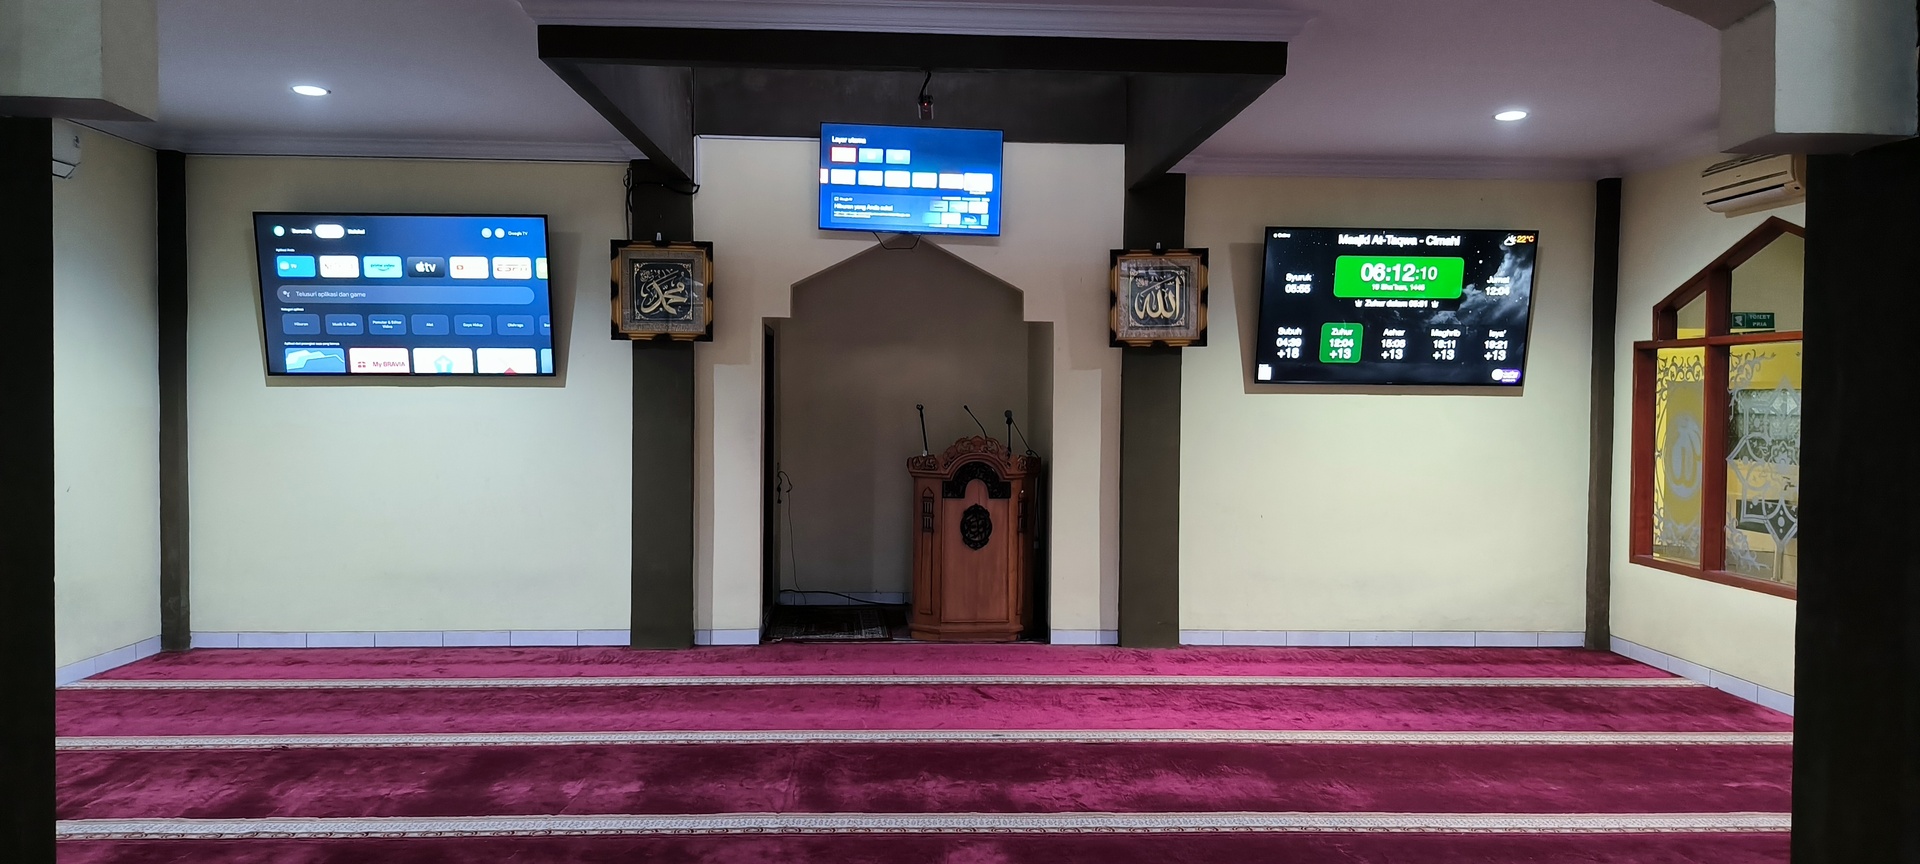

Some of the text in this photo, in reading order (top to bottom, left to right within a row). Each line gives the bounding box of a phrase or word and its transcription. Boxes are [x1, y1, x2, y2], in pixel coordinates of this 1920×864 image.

[1337, 234, 1371, 248] Masjid
[1425, 235, 1461, 247] Cimahi
[1285, 273, 1312, 283] Syuruk
[1360, 263, 1438, 282] 06:12:10
[318, 290, 338, 299] aplikasi
[350, 291, 366, 299] game
[1278, 326, 1303, 336] Subuh
[1330, 327, 1354, 336] Zuhur
[1430, 328, 1462, 339] Maghrib
[1329, 347, 1352, 360] +13
[1380, 348, 1404, 360] +13
[1432, 349, 1455, 361] +13
[1484, 350, 1507, 361] +13
